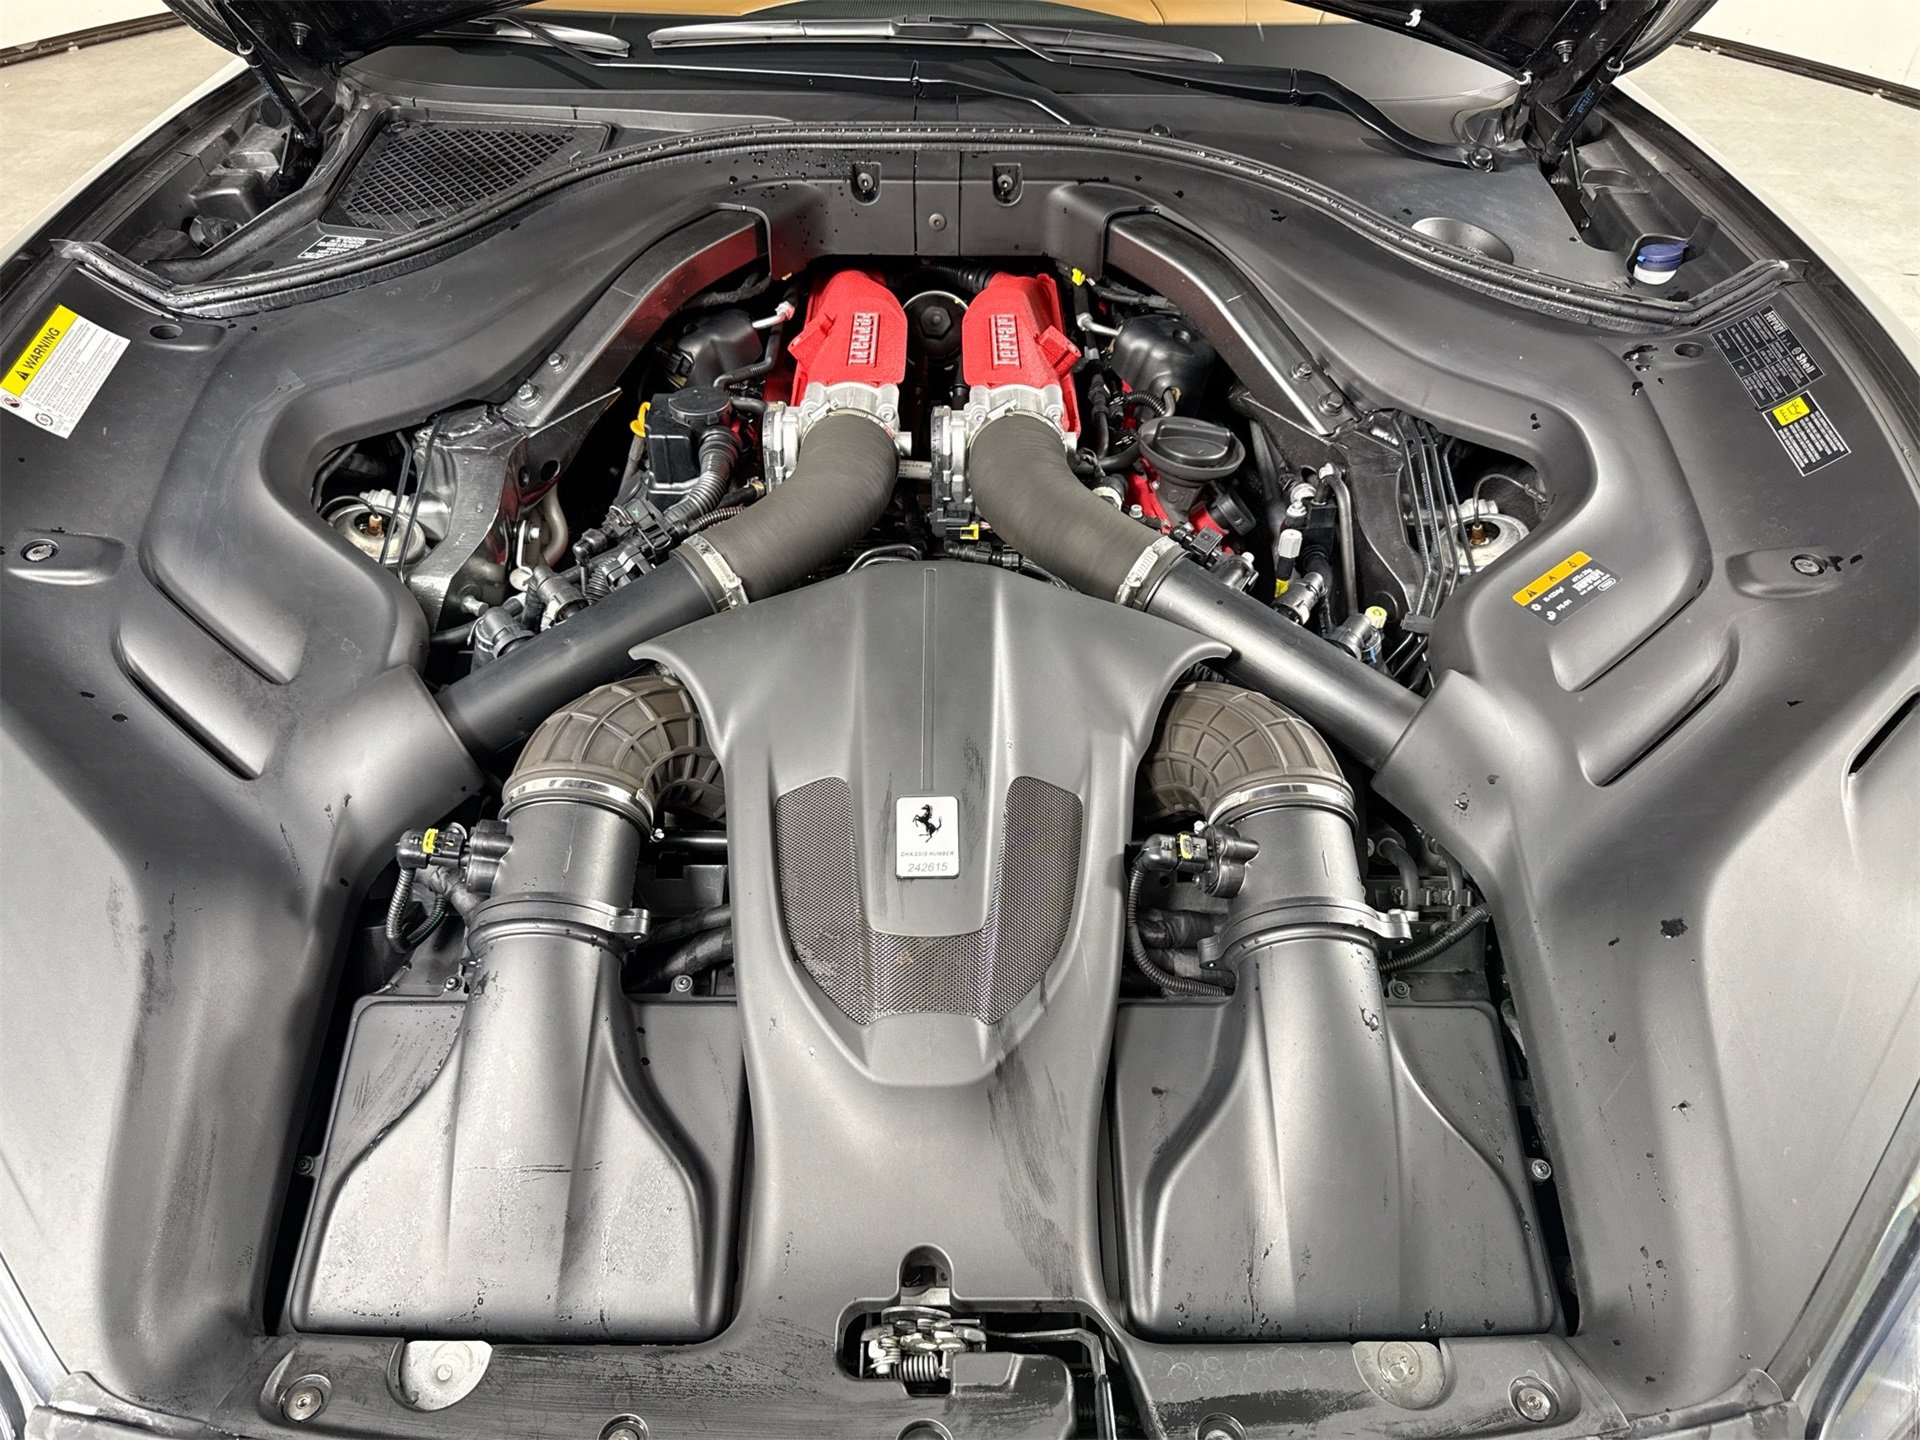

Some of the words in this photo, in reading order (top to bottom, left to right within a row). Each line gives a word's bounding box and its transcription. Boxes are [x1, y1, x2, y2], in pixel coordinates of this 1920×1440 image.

[848, 311, 879, 365] Ferrari
[1764, 310, 1787, 334] Ferrari
[23, 327, 60, 370] WARNING
[990, 313, 1020, 367] Ferrari
[1795, 352, 1816, 374] Shell
[908, 862, 948, 872] 242615
